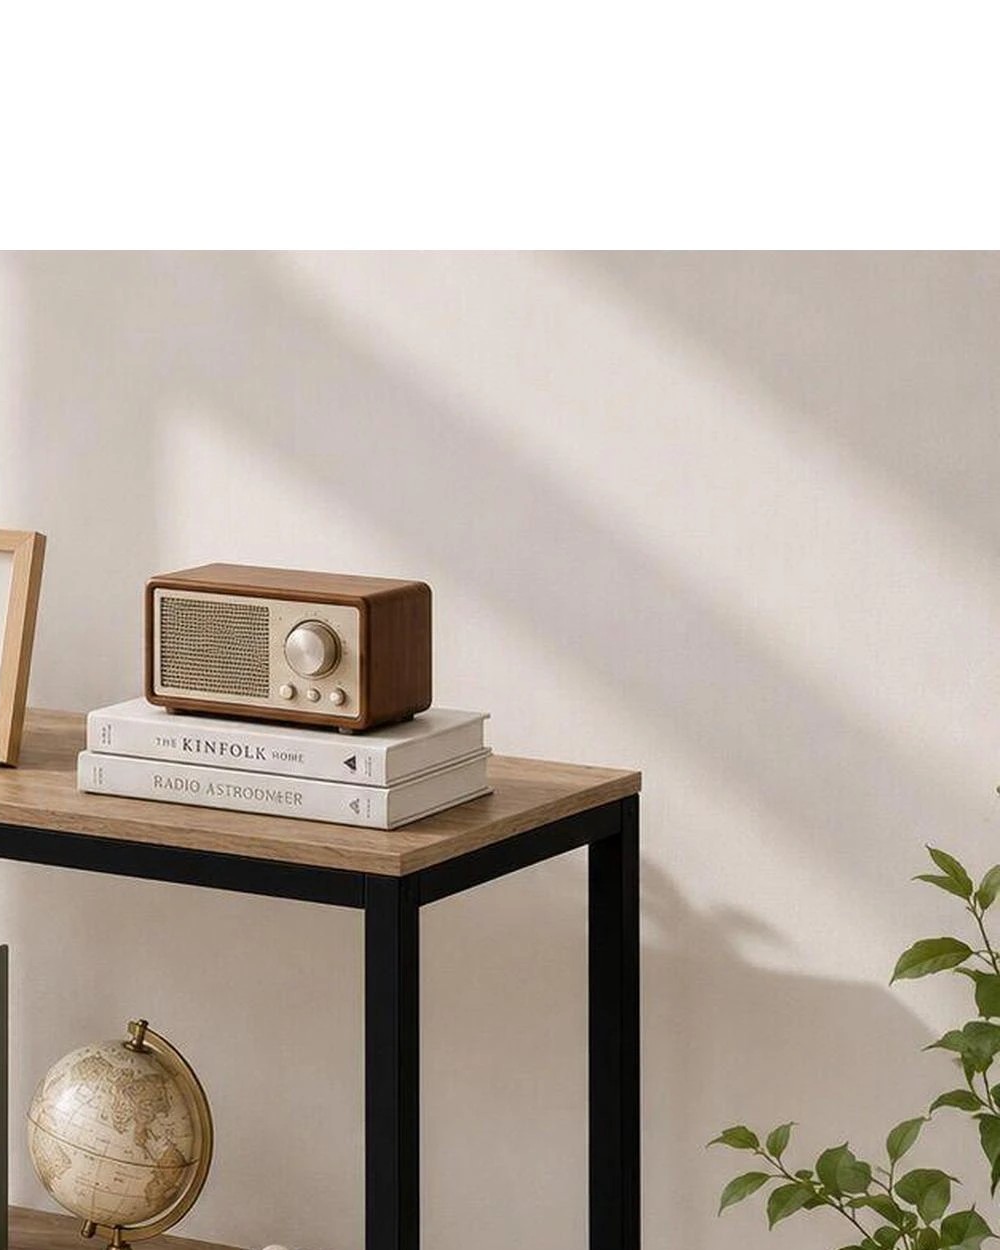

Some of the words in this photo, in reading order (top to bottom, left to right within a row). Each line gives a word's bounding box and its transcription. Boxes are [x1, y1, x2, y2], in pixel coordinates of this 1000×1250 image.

[155, 736, 178, 749] THE
[182, 737, 267, 761] KINFOLK
[153, 774, 201, 793] RADIO
